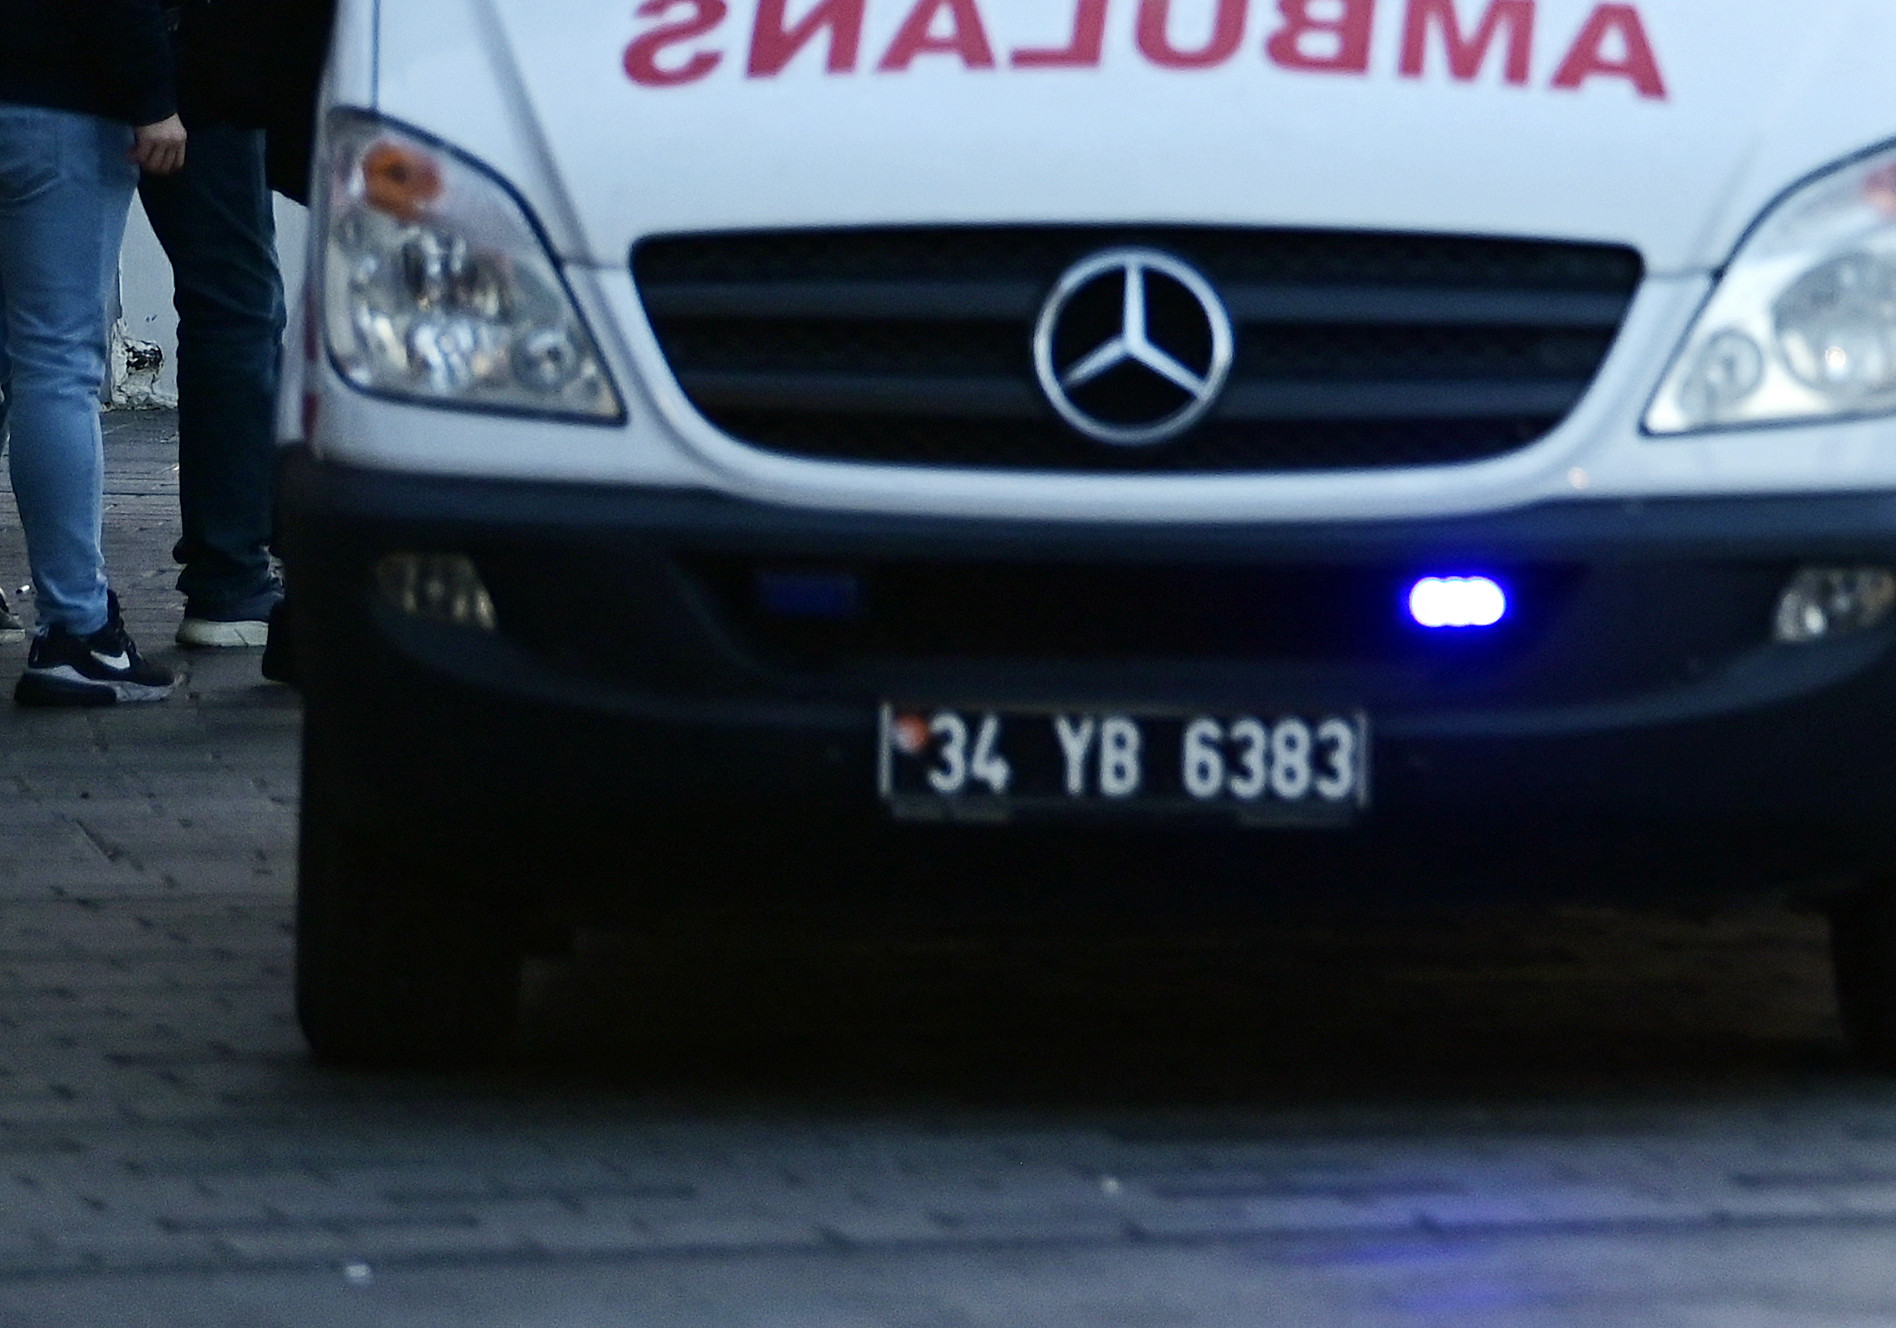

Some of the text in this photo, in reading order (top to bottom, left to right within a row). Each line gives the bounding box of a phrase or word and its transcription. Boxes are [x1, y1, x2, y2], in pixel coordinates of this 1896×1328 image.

[927, 708, 1356, 800] 34 YB 6383
